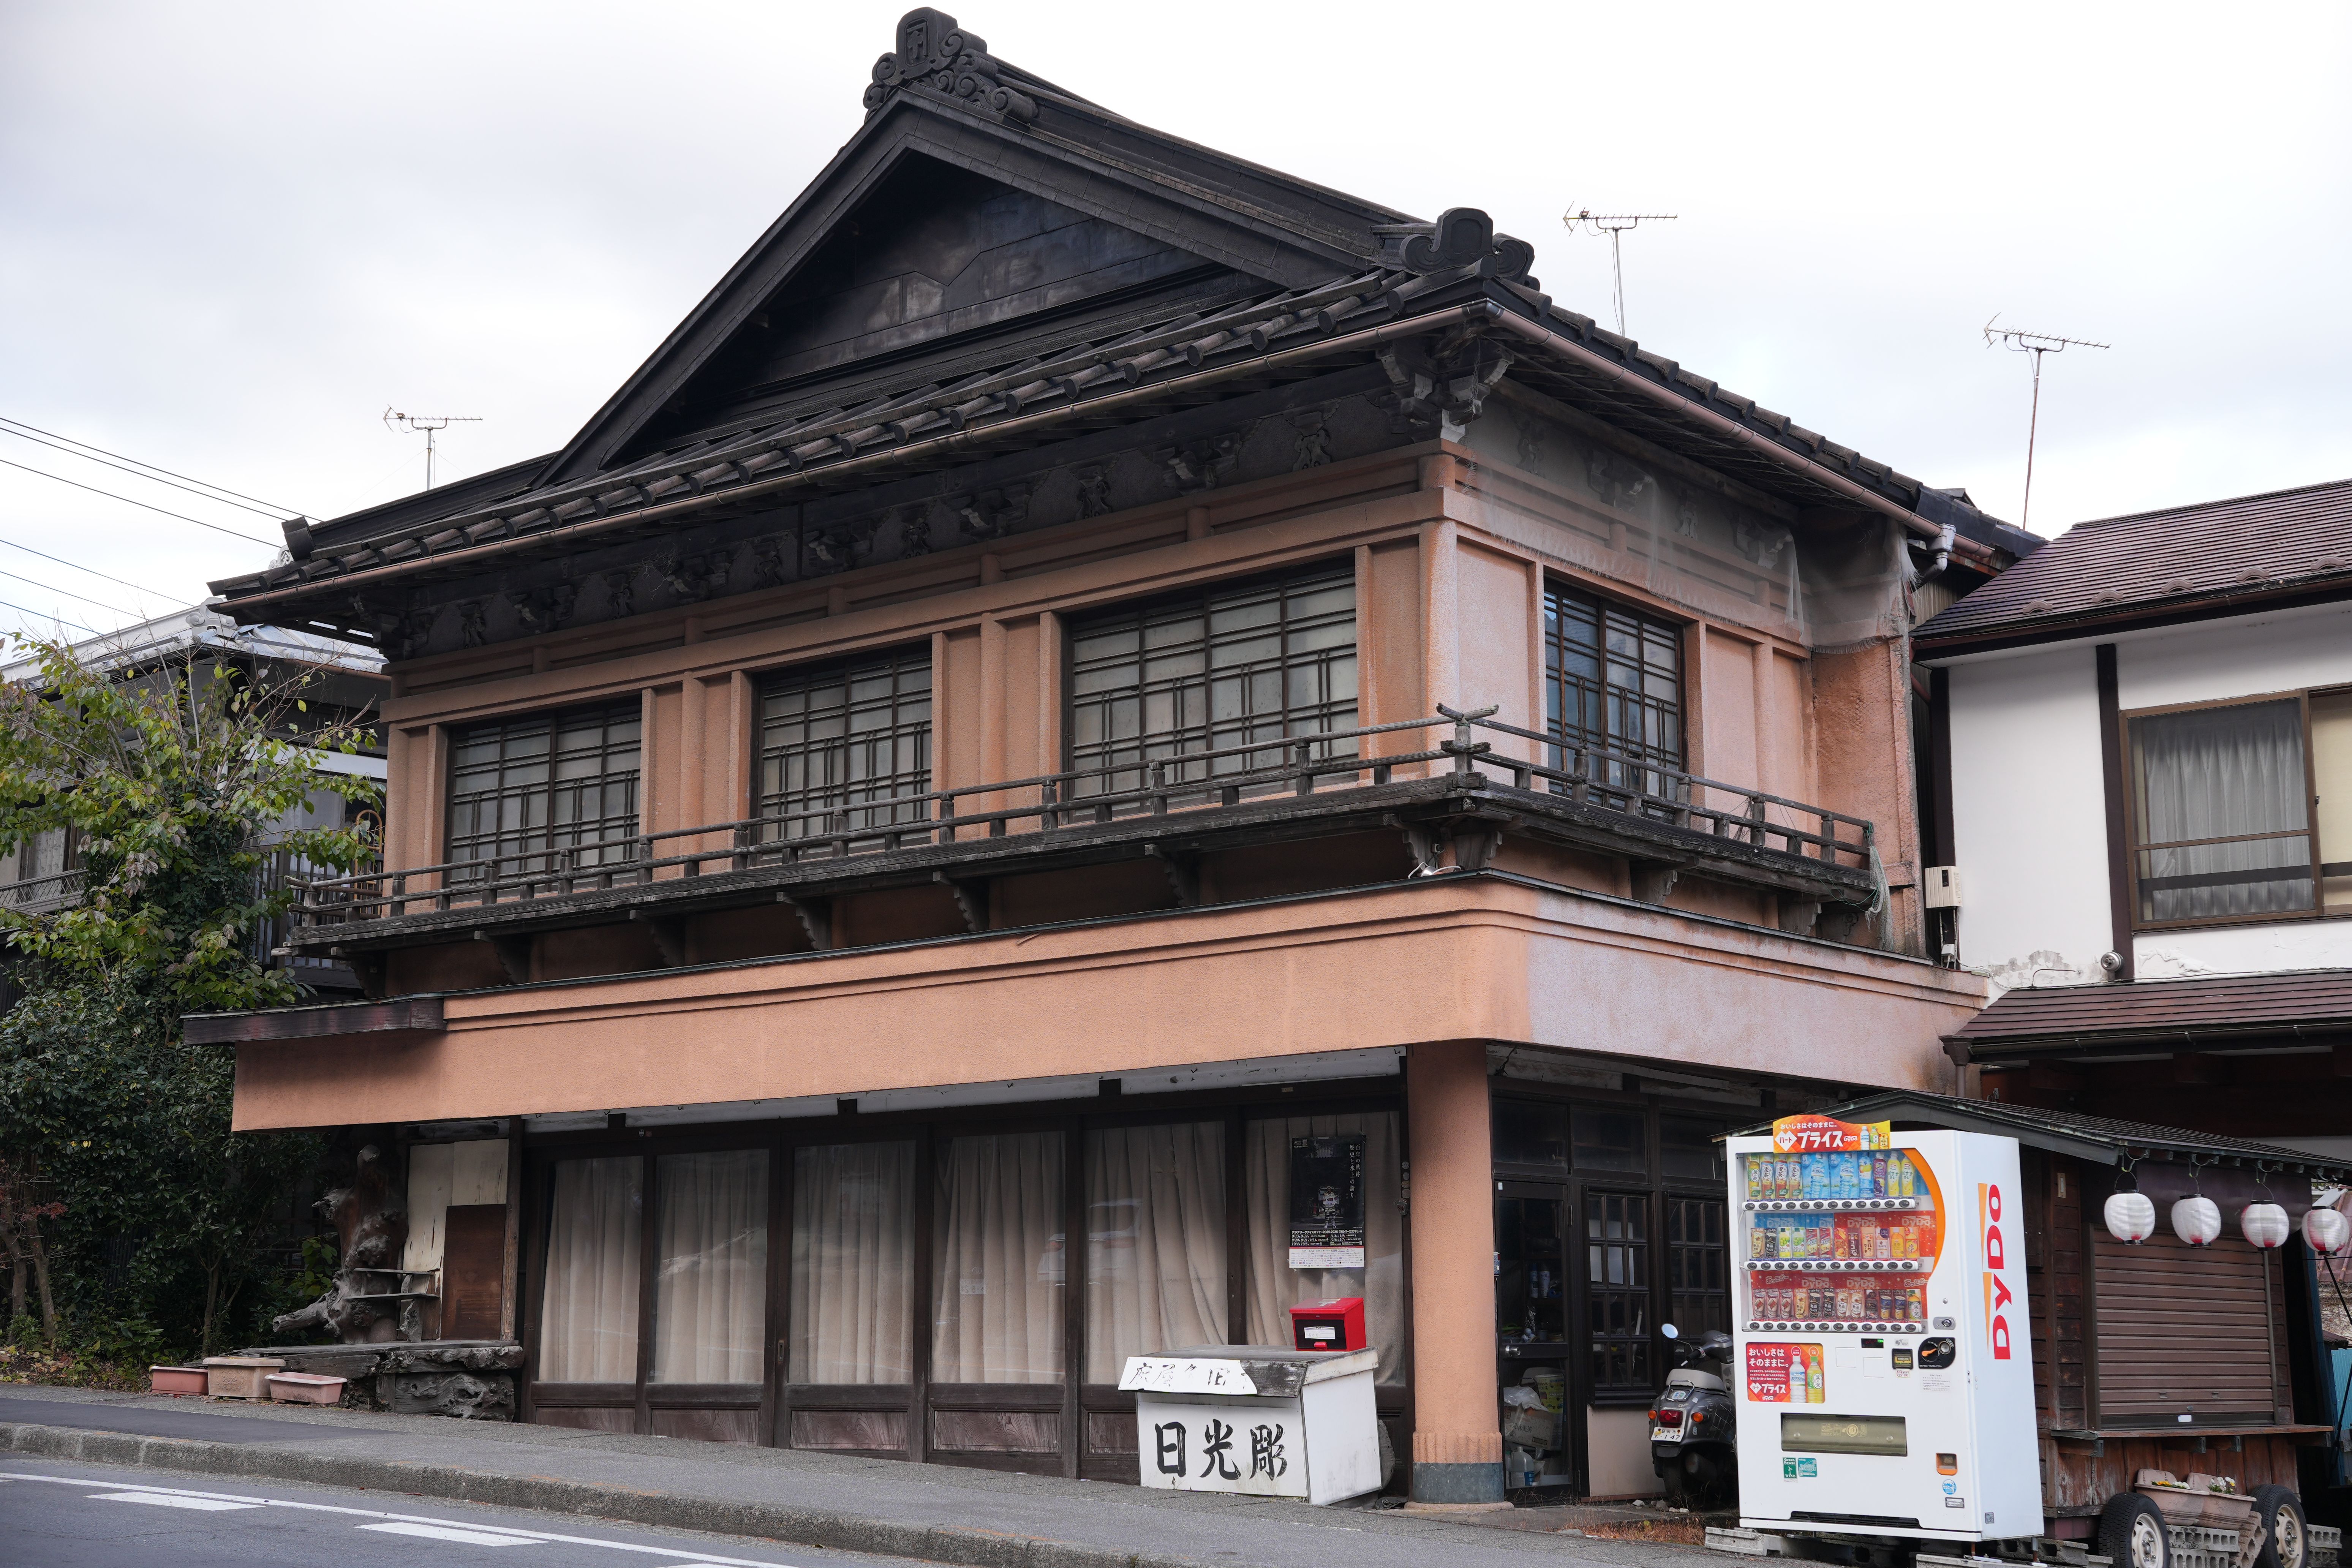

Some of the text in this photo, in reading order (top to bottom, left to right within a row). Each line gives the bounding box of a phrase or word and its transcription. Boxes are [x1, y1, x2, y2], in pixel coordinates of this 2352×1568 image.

[1797, 1130, 1844, 1149] プライス
[1902, 1218, 1931, 1228] DyDo
[1987, 1184, 2012, 1360] DyDo
[1802, 1279, 1830, 1288] DyDo
[1846, 1279, 1875, 1288] DyDo
[1748, 1348, 1785, 1357] おいしさは
[1749, 1359, 1789, 1367] そのままに。
[1761, 1384, 1786, 1394] プライス
[1155, 1418, 1288, 1481] 日光彫
